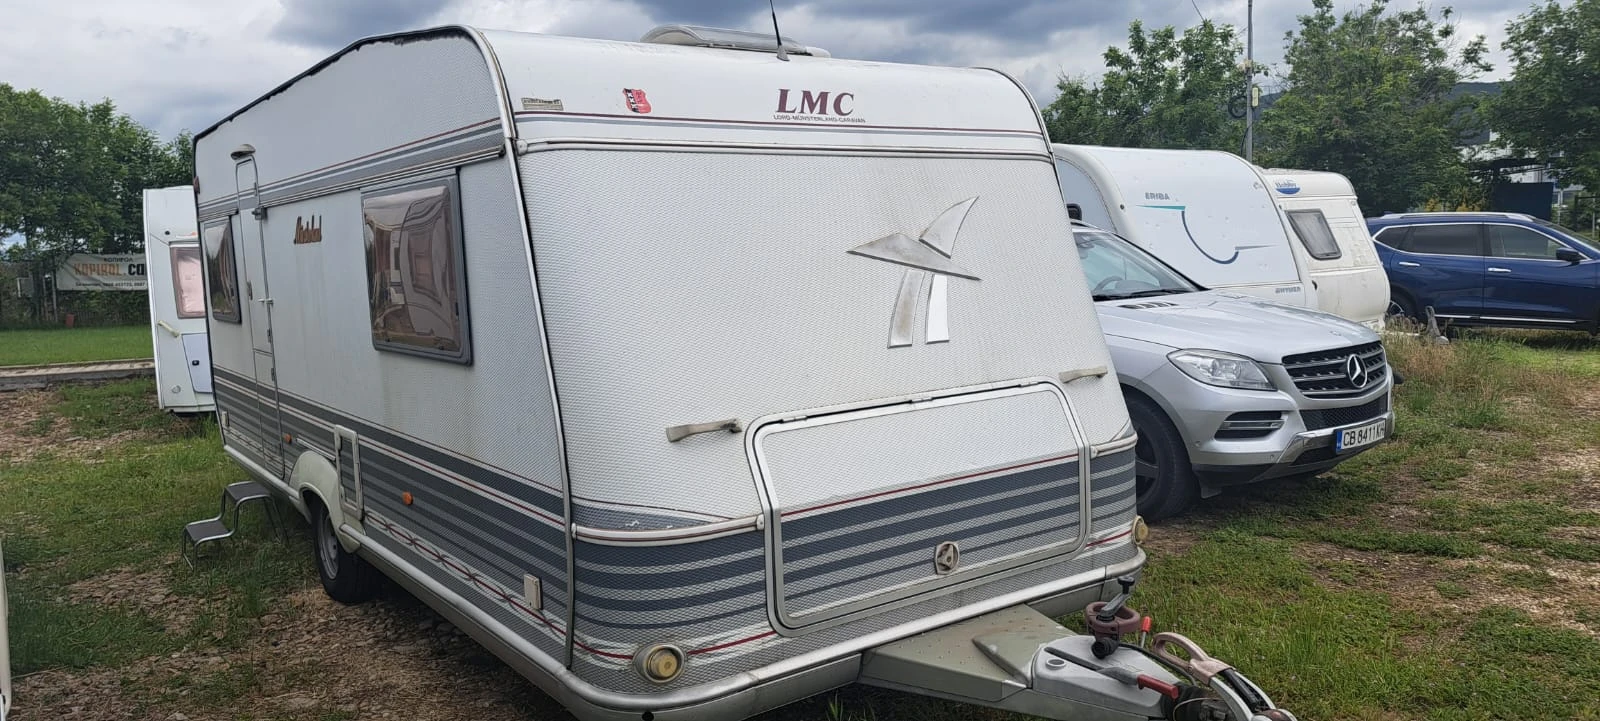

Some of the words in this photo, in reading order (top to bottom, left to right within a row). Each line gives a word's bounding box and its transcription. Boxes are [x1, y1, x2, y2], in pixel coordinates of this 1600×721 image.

[775, 88, 854, 116] LMC
[1144, 192, 1170, 200] ERIBA
[1343, 430, 1356, 447] CB
